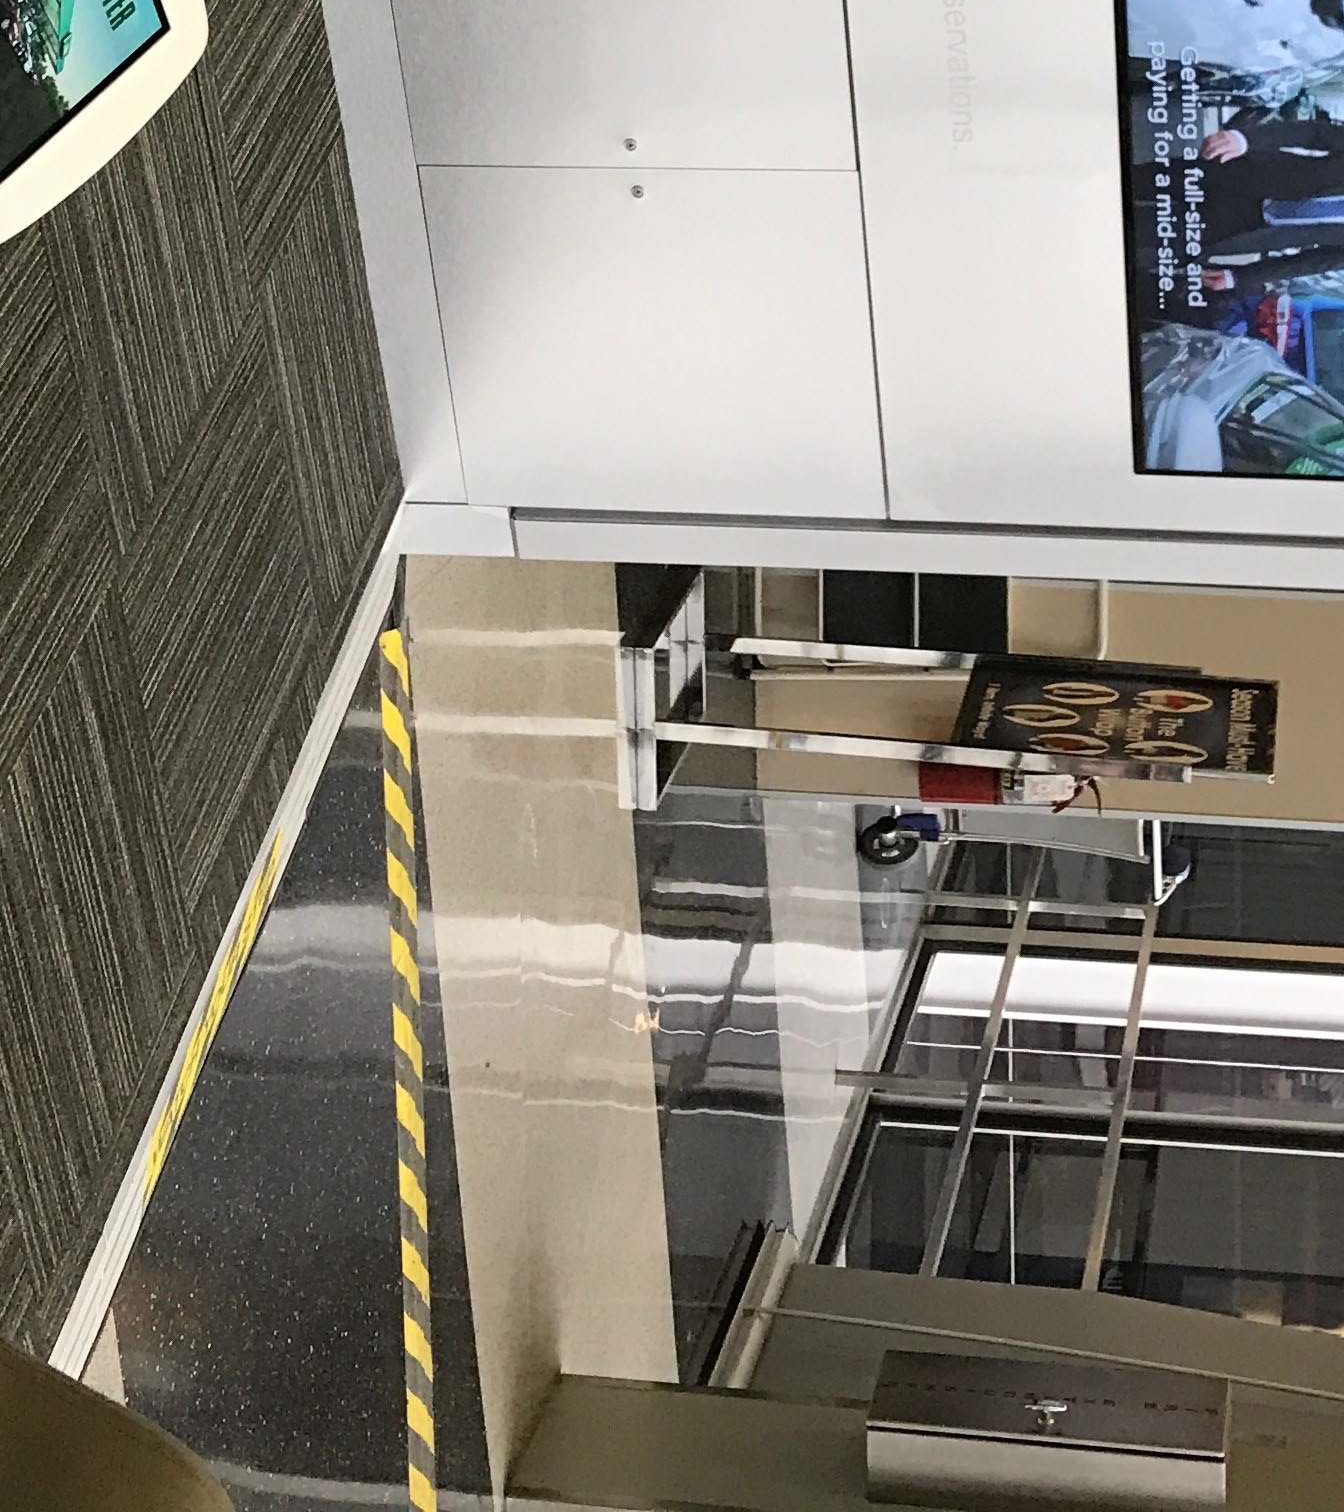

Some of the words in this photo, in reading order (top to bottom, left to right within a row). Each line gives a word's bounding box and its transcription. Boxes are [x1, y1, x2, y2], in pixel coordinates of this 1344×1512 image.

[1146, 40, 1172, 124] paying
[1177, 45, 1203, 140] Getting
[1153, 130, 1174, 168] for
[1182, 146, 1199, 161] a
[1155, 173, 1173, 188] a
[1183, 167, 1207, 256] full-size
[1156, 193, 1178, 310] mid-size...
[1187, 263, 1208, 308] and
[1157, 717, 1185, 737] The
